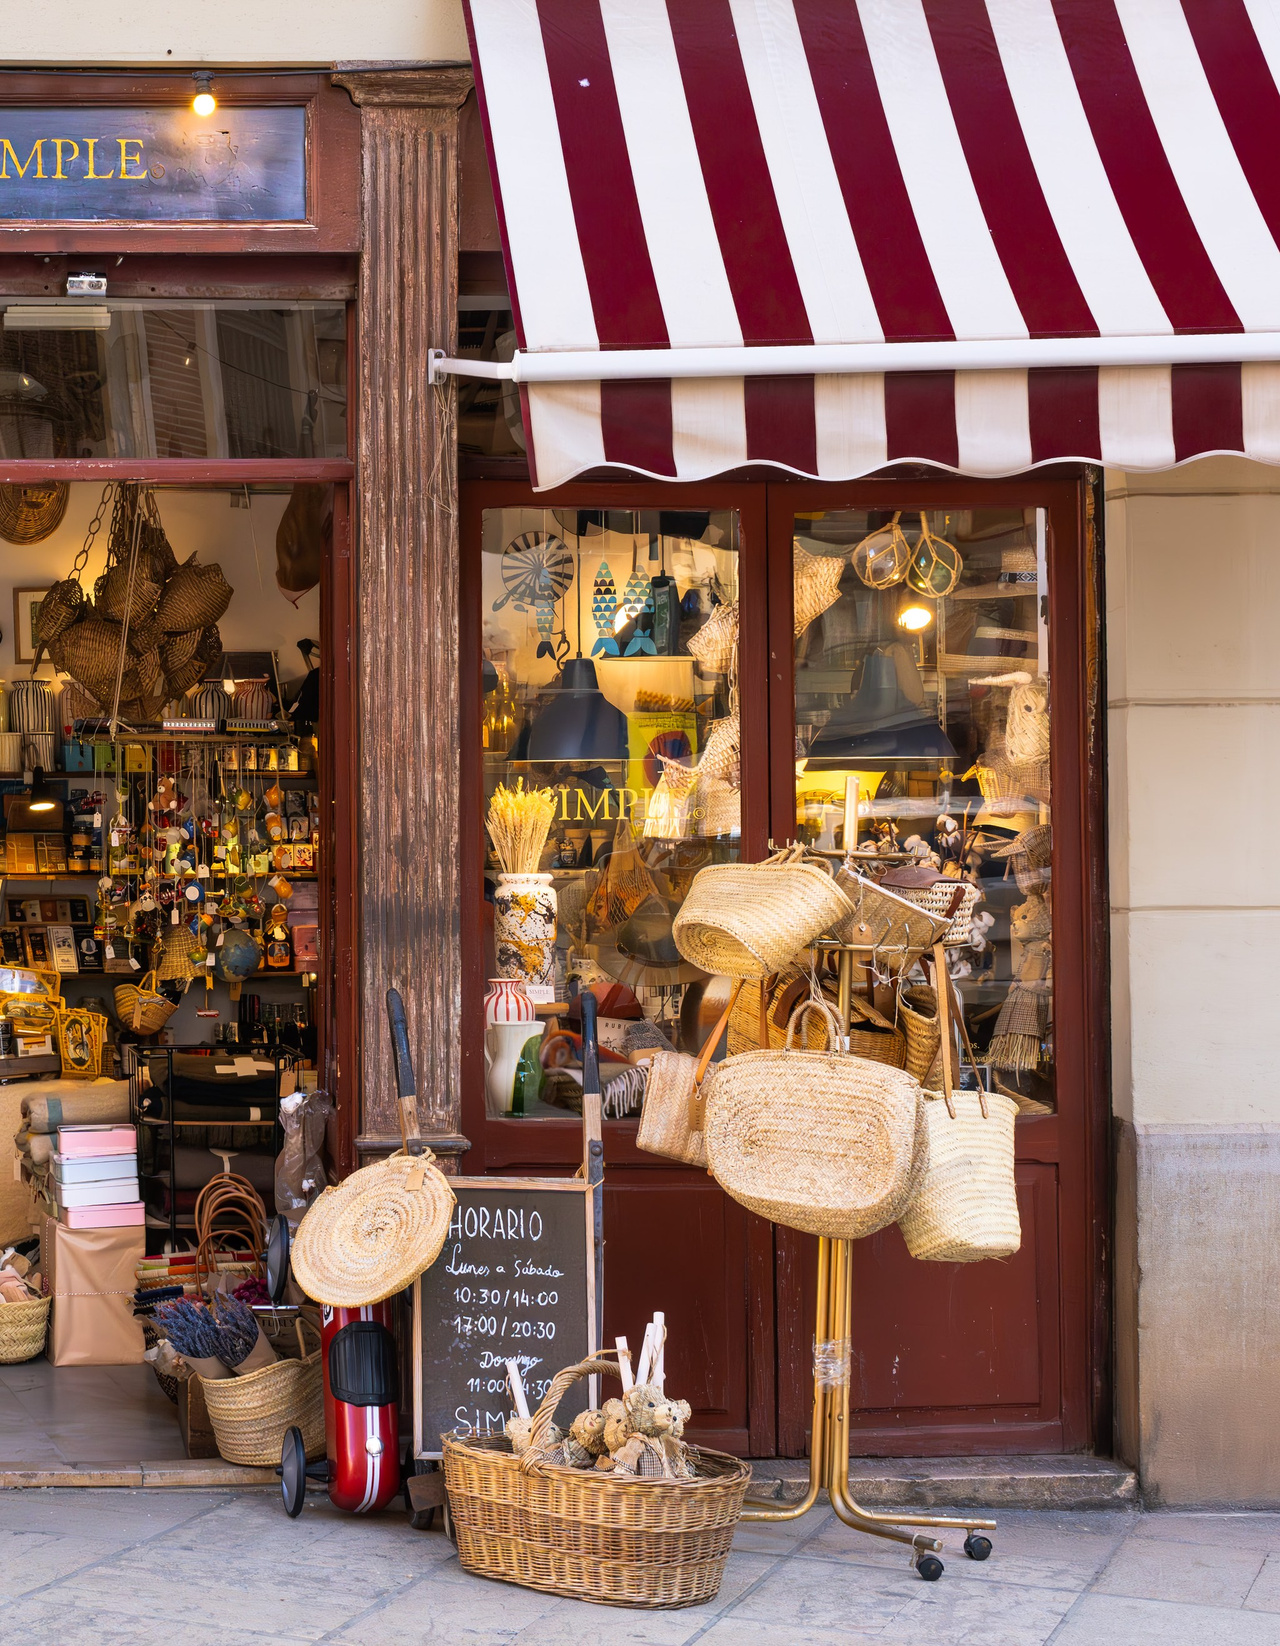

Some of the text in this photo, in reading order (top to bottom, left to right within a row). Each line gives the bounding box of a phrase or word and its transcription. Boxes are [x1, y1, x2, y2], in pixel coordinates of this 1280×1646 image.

[448, 1205, 543, 1241] HORARIO
[445, 1243, 565, 1278] Lunes a Sábado
